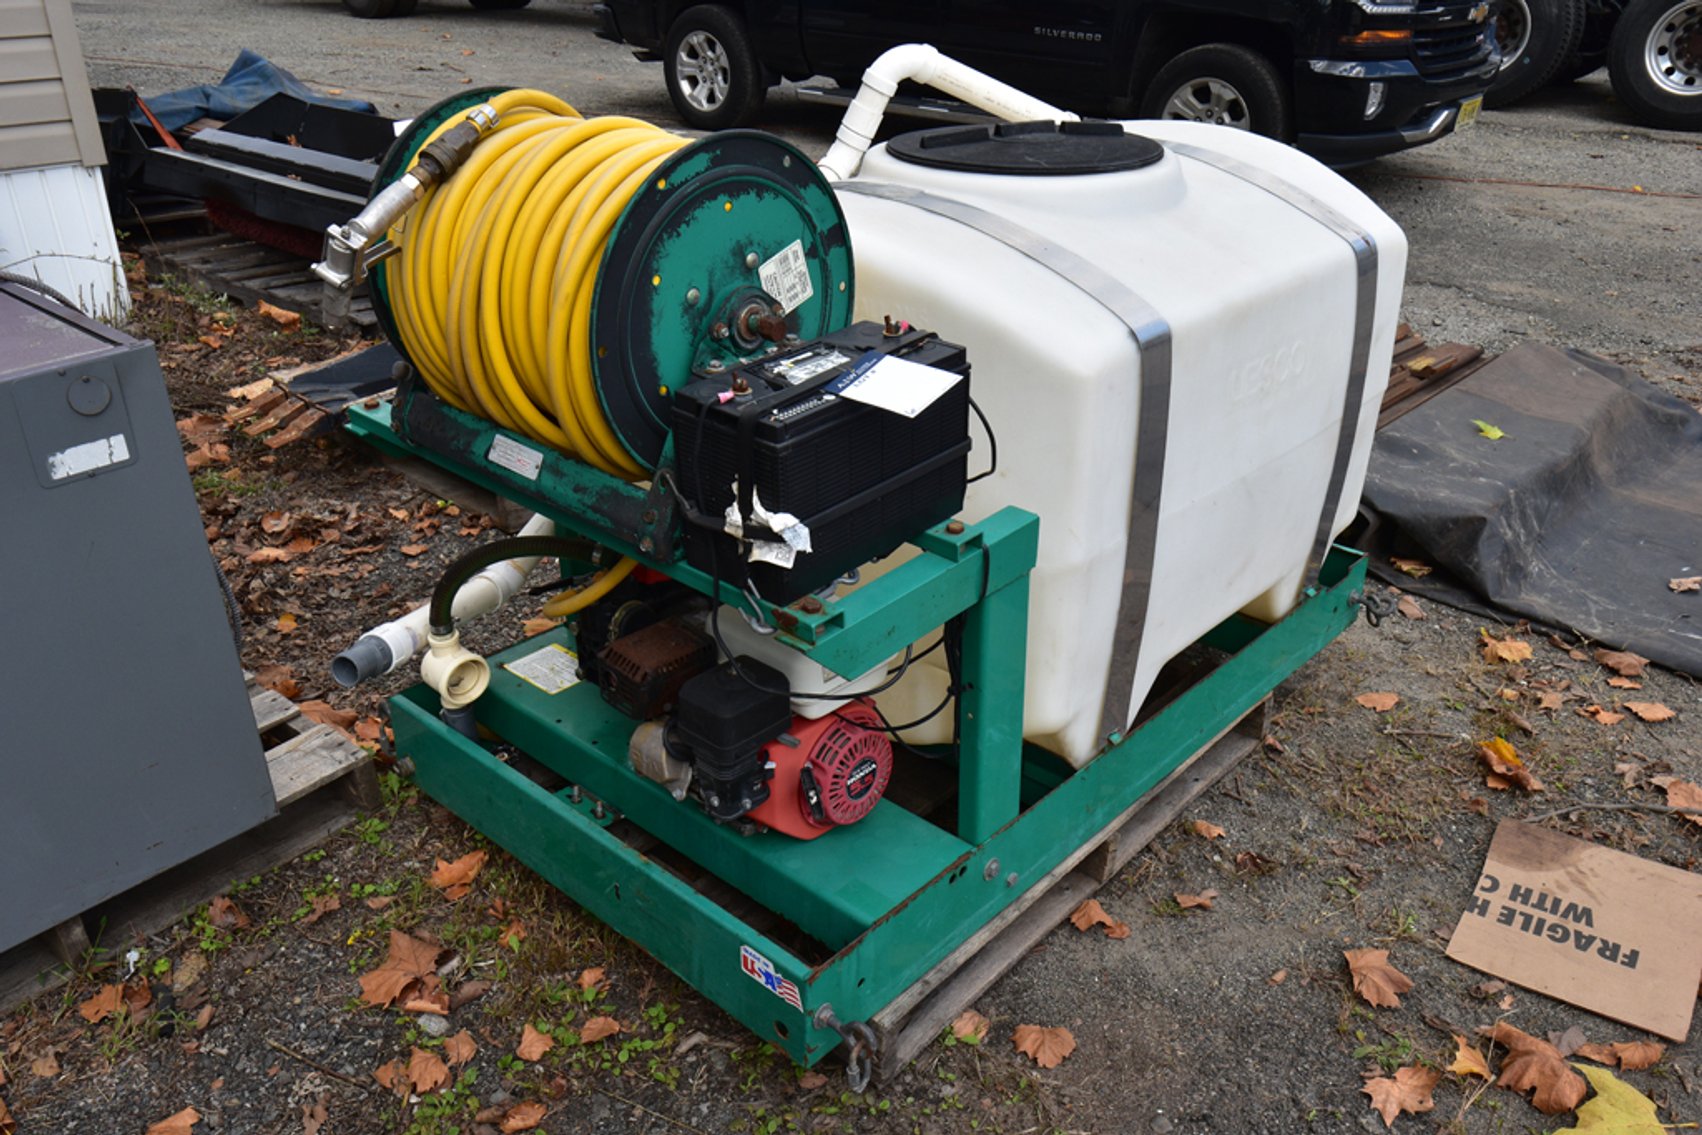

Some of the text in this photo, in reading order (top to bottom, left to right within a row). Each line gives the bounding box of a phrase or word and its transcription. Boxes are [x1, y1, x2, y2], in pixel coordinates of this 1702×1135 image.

[1033, 26, 1103, 41] SILVERADO
[1508, 882, 1595, 929] WITH
[1496, 904, 1641, 970] FRAGILE
